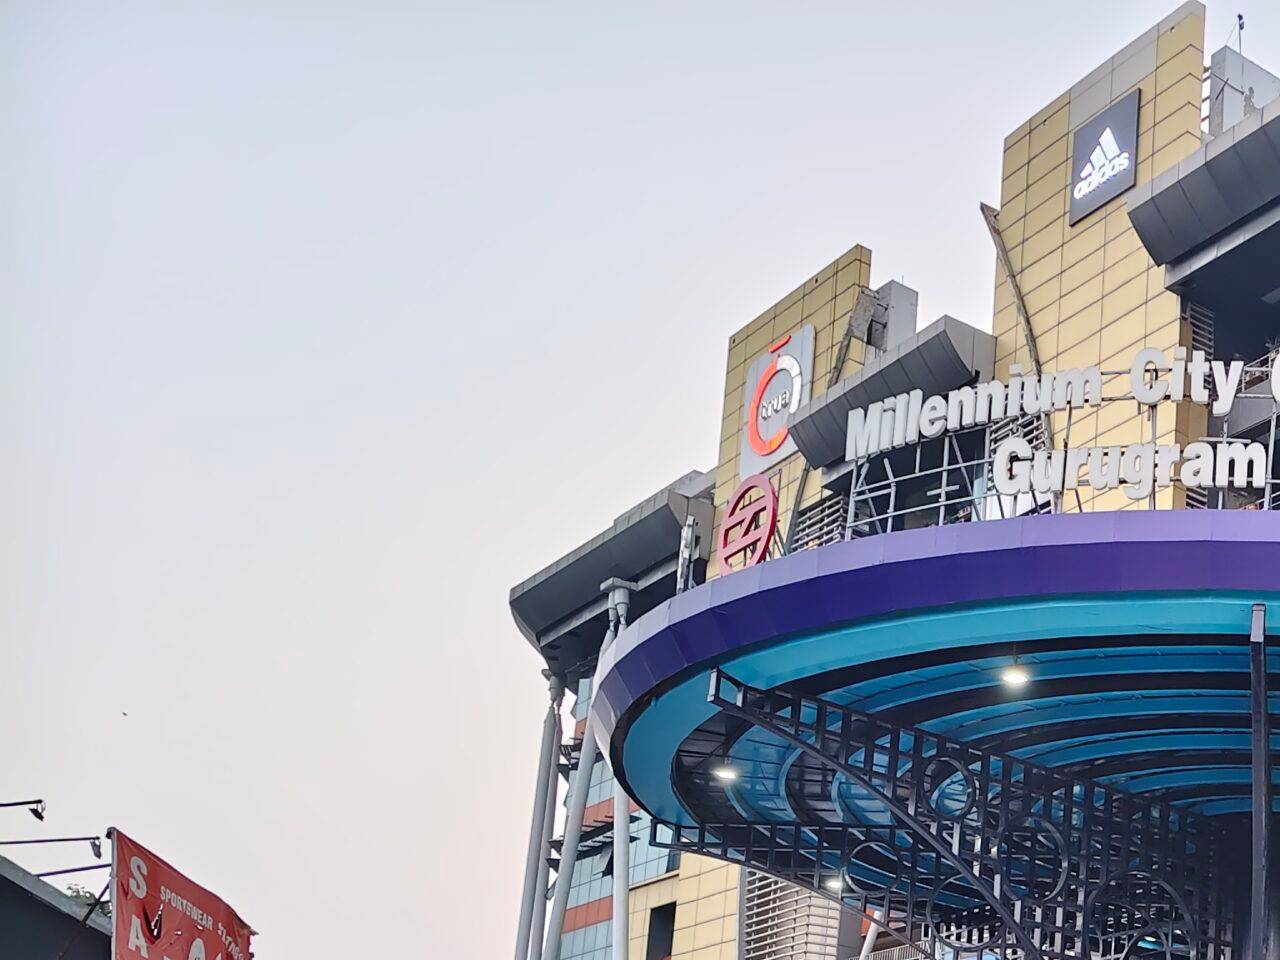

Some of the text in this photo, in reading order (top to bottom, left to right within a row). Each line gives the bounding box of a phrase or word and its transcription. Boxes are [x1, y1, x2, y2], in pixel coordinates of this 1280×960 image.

[1073, 152, 1130, 199] adidas
[845, 362, 1102, 463] Millennium
[1130, 347, 1245, 417] City
[993, 437, 1267, 500] Gurugram
[160, 885, 214, 931] SPORTSWEAR
